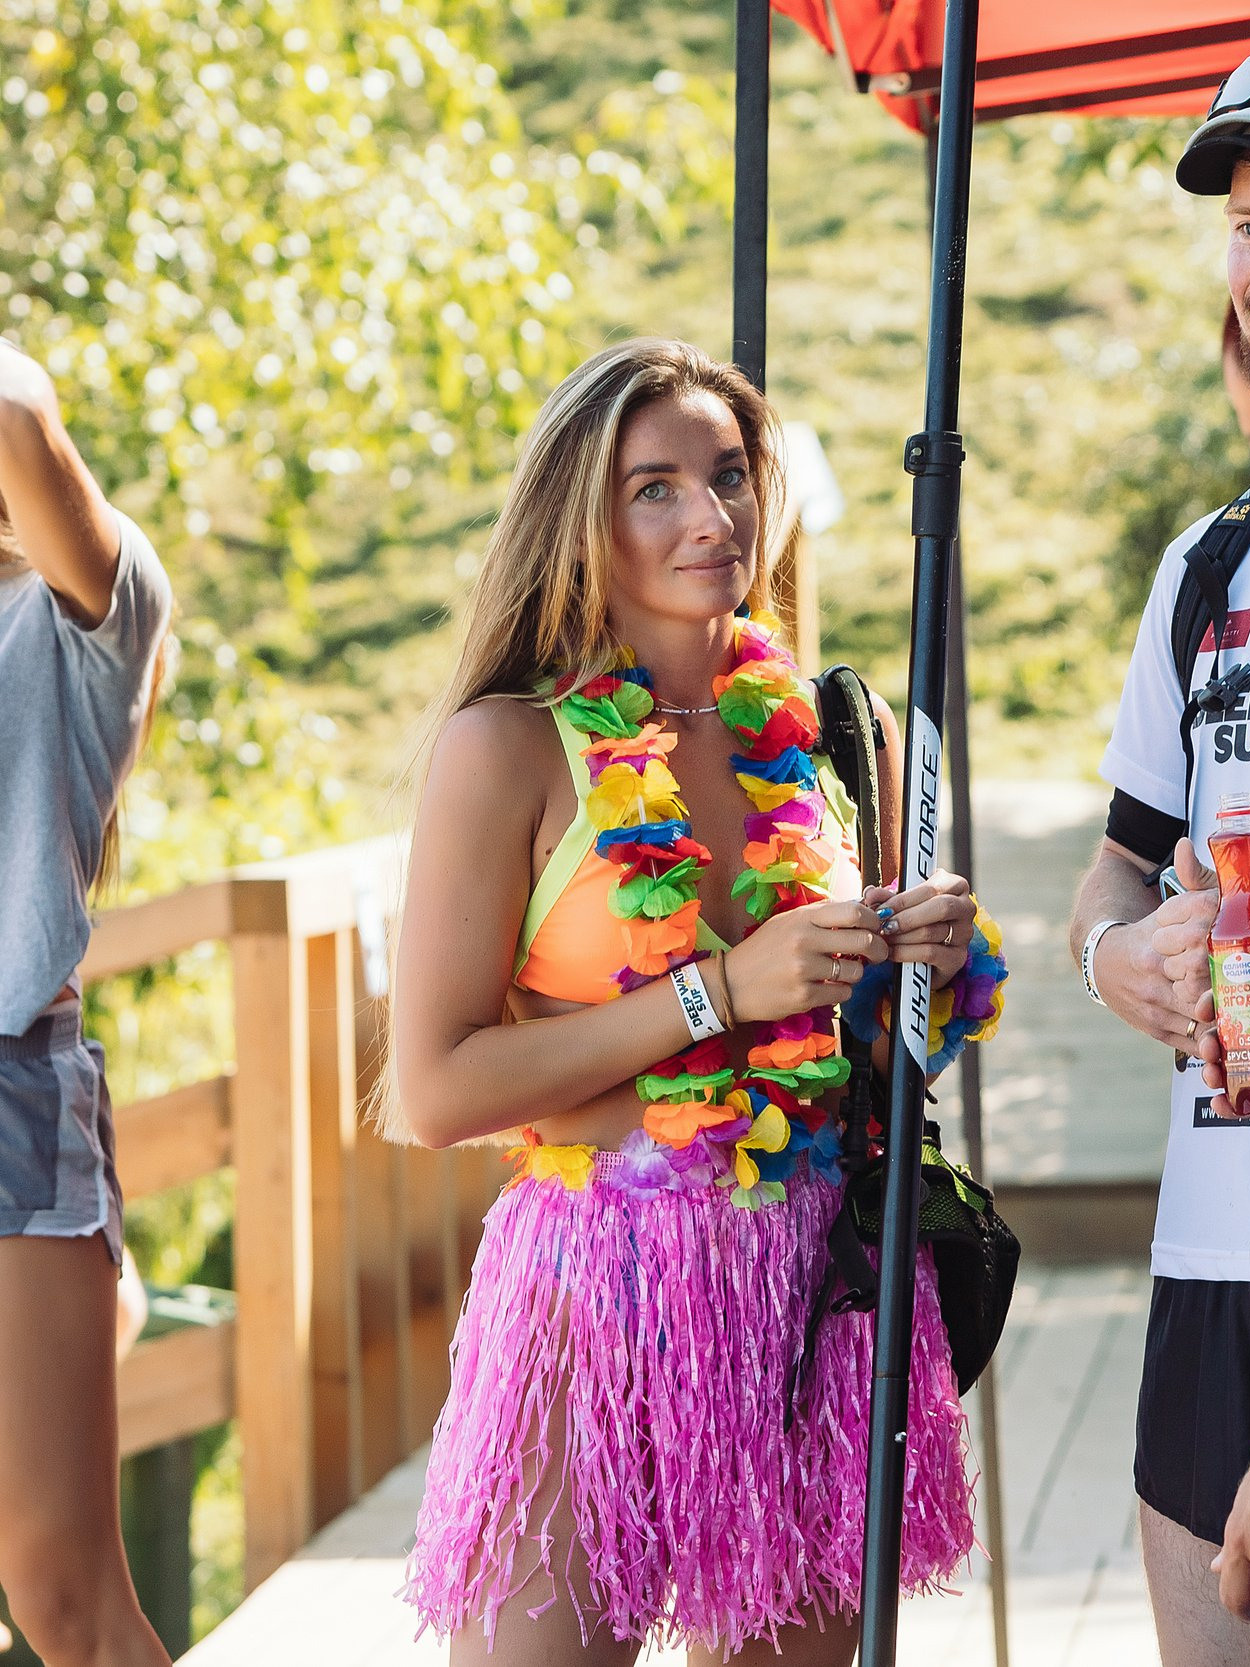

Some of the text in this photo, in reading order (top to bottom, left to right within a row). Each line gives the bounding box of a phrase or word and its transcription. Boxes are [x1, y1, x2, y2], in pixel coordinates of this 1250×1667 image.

[918, 744, 938, 882] FORCE
[682, 996, 704, 1028] DEEP
[690, 988, 707, 1012] SUP
